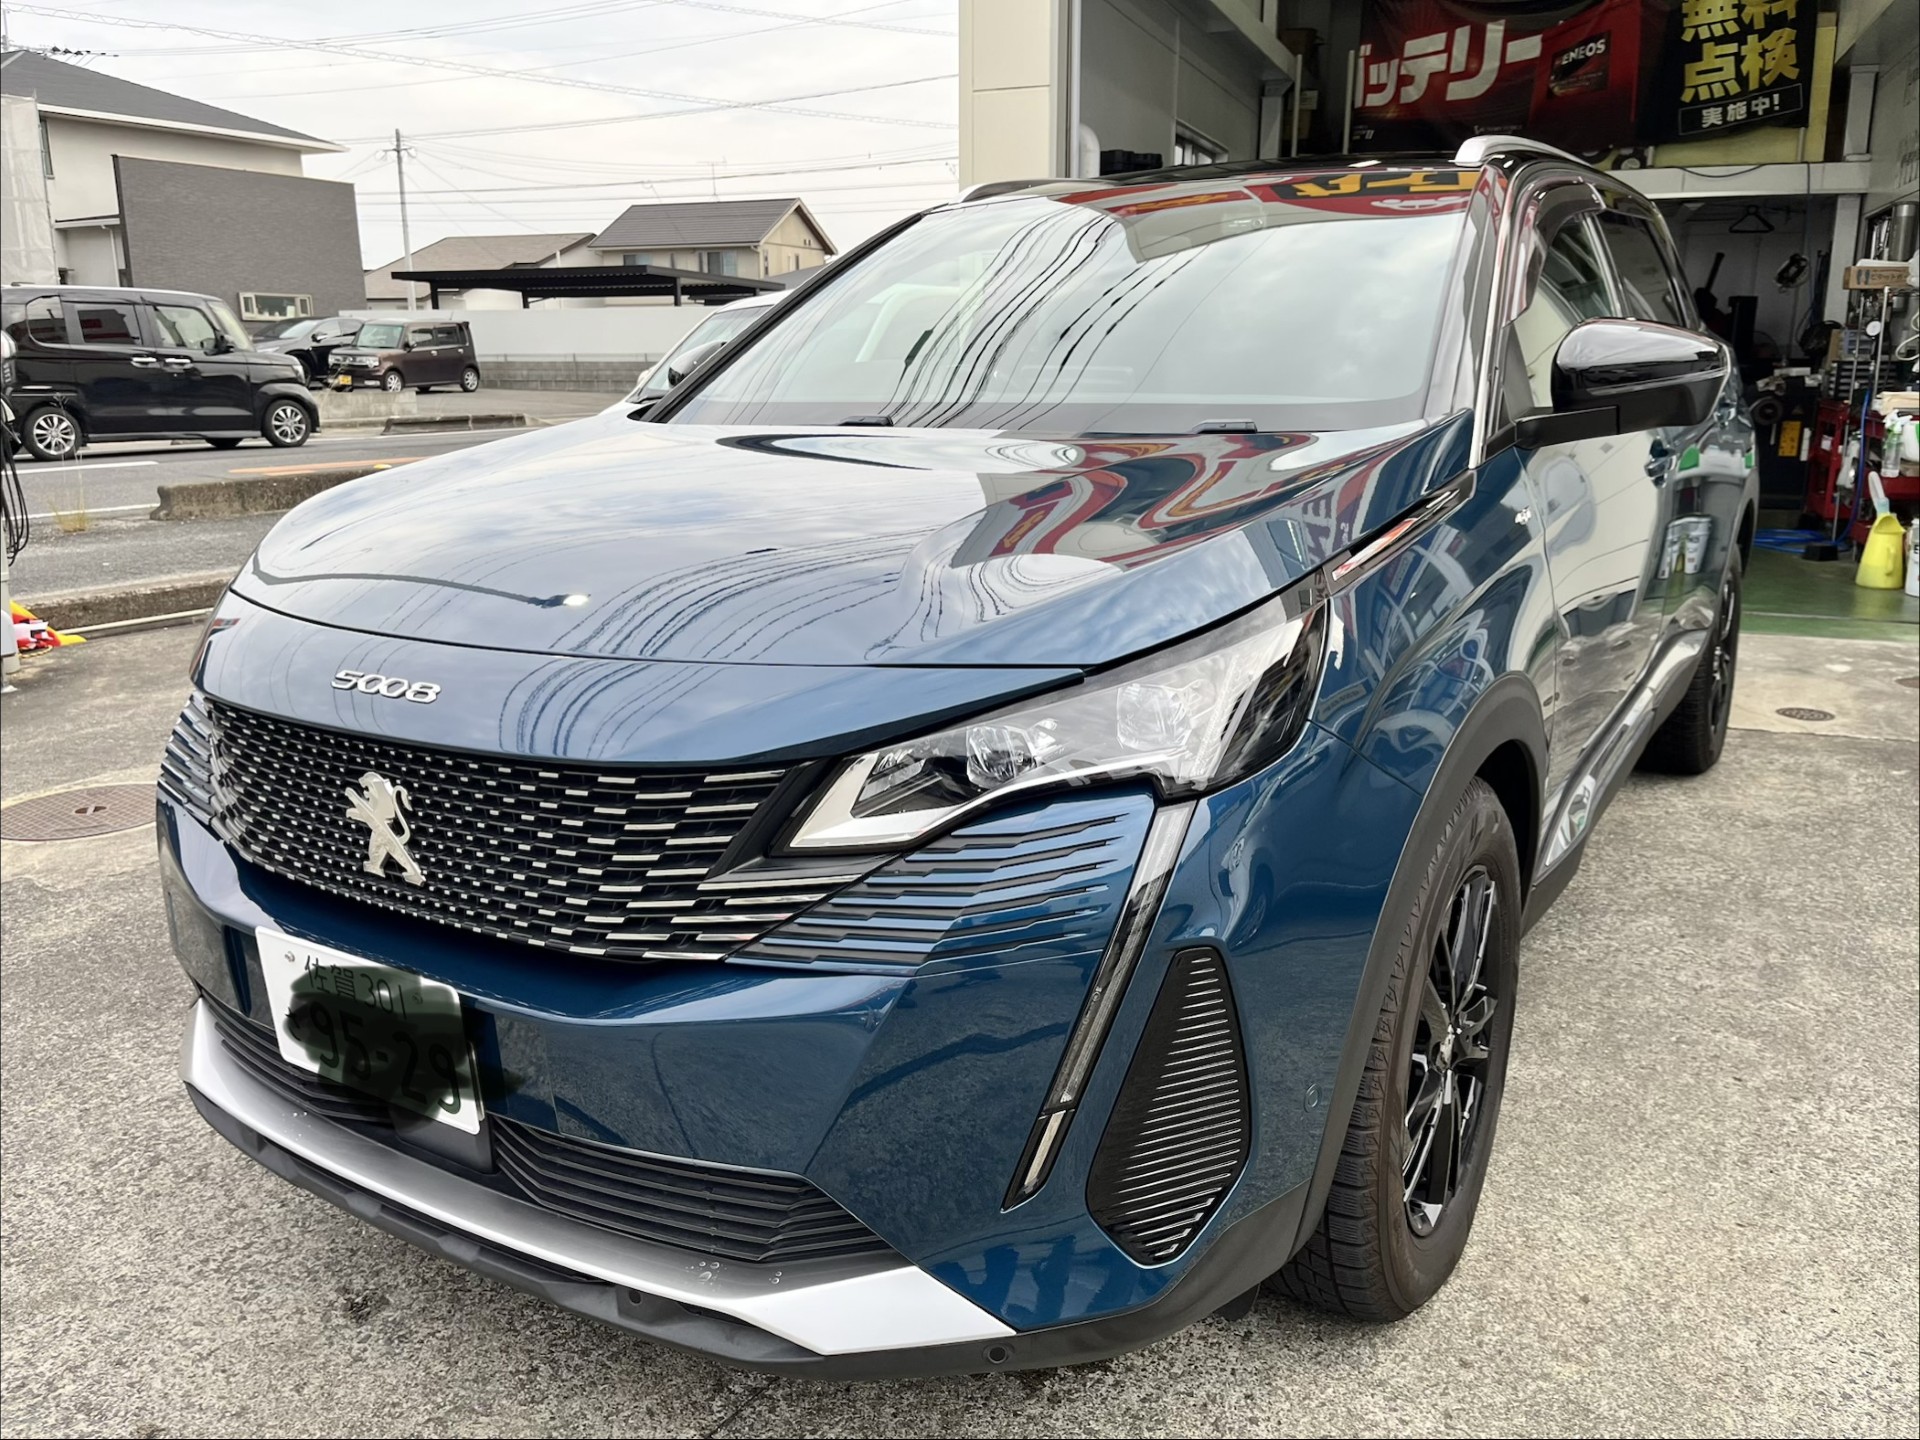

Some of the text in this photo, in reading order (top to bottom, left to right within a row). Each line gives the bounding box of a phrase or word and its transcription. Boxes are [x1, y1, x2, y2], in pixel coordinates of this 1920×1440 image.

[1560, 38, 1607, 66] ENEOS
[1680, 27, 1800, 103] 点検
[330, 669, 442, 704] 5008
